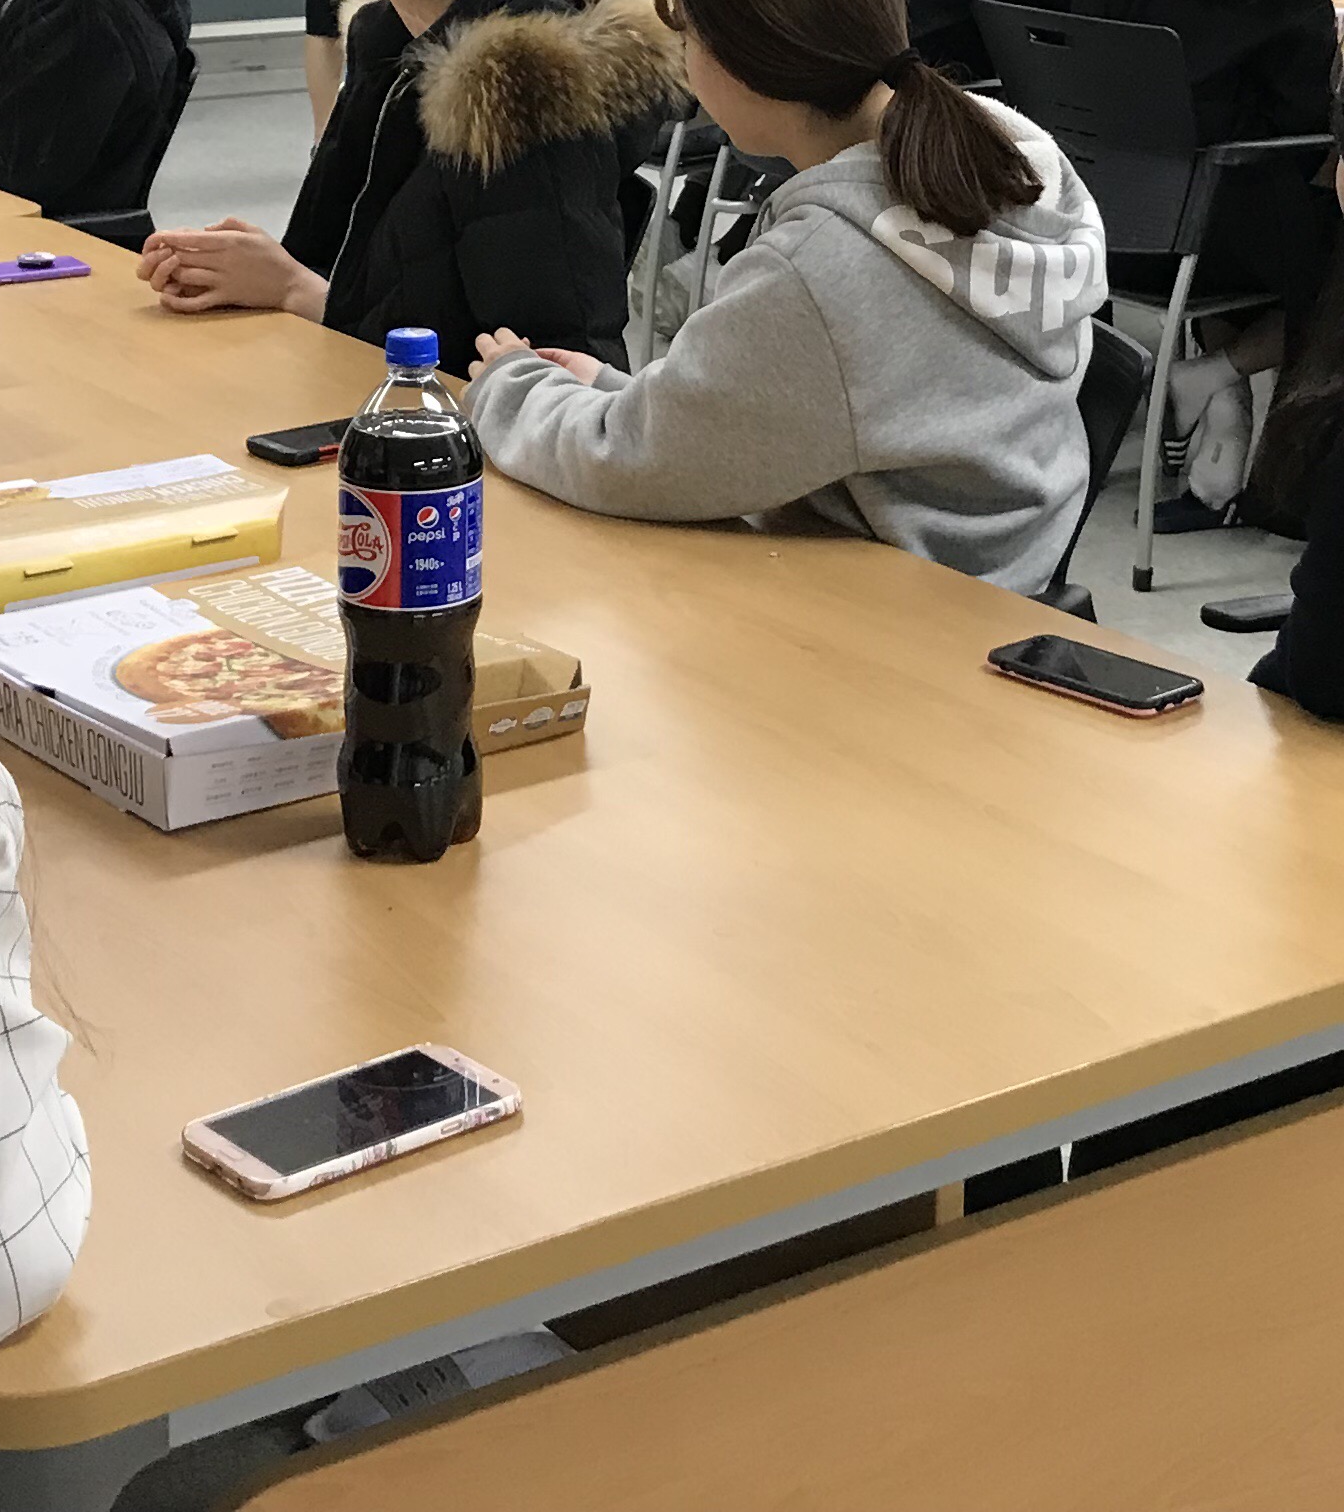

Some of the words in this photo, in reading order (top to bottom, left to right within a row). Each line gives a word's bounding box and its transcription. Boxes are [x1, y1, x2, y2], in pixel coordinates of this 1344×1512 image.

[408, 528, 446, 544] pepsi
[188, 579, 309, 632] CHICKEN
[25, 697, 86, 773] CHICKEN
[87, 728, 144, 807] GONGJU
